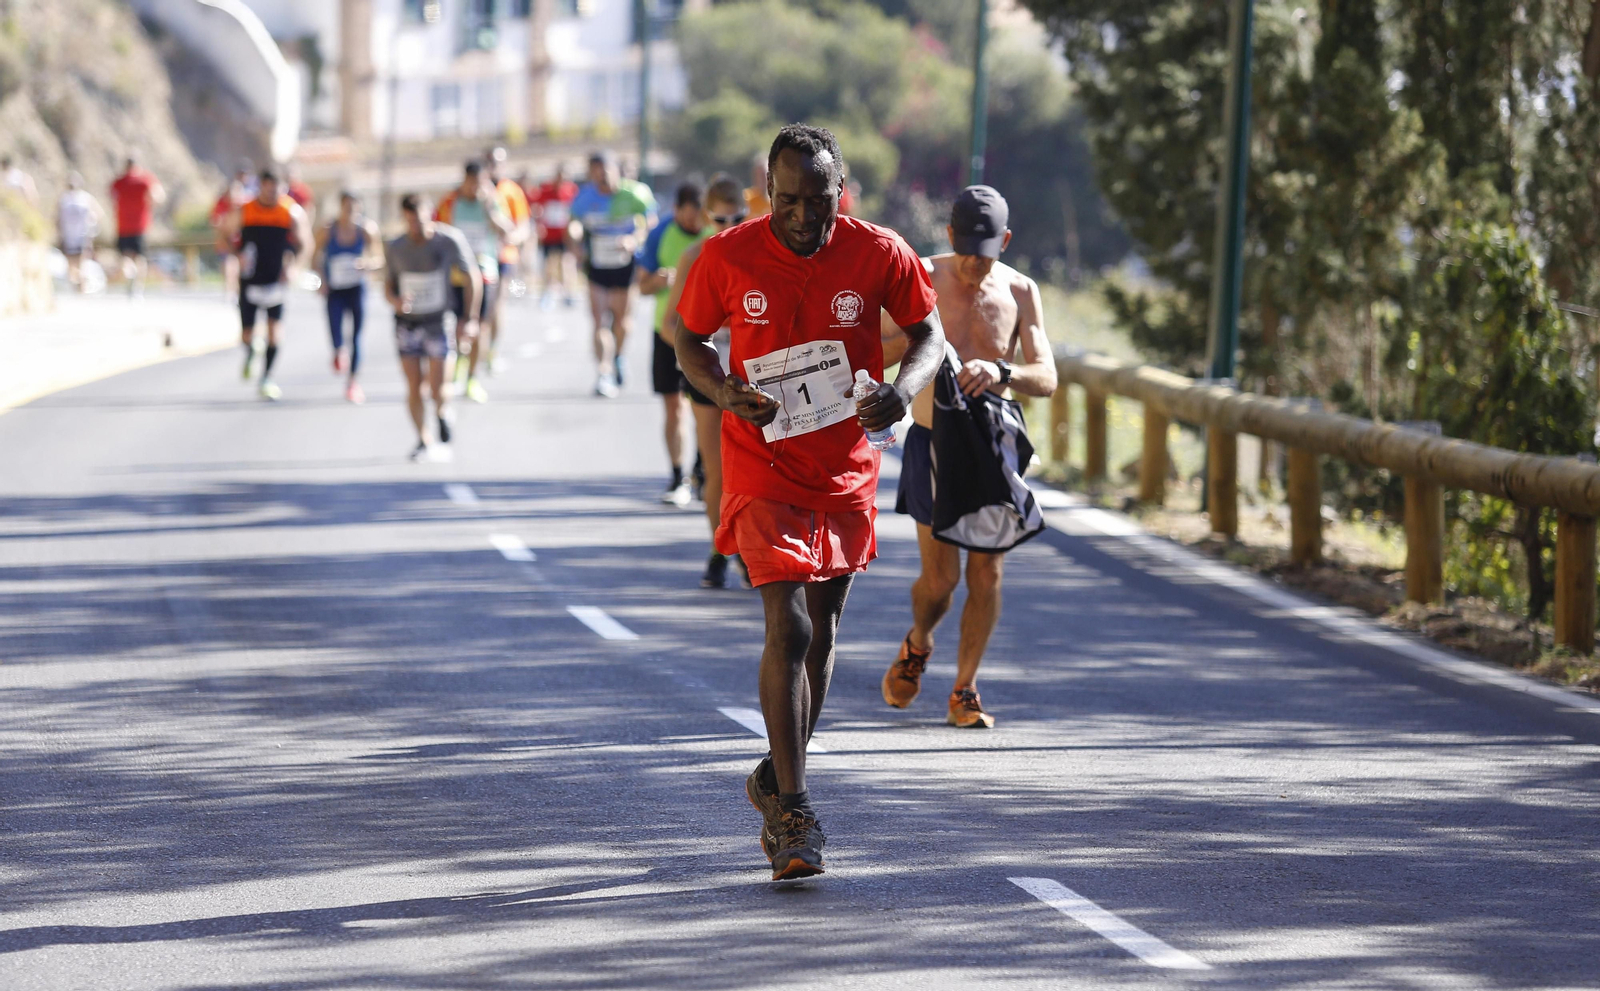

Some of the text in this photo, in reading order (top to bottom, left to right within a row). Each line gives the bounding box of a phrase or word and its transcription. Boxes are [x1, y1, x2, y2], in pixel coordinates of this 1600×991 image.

[748, 298, 761, 309] FIAT
[763, 358, 790, 368] Ayuntamieno
[797, 383, 812, 404] 1
